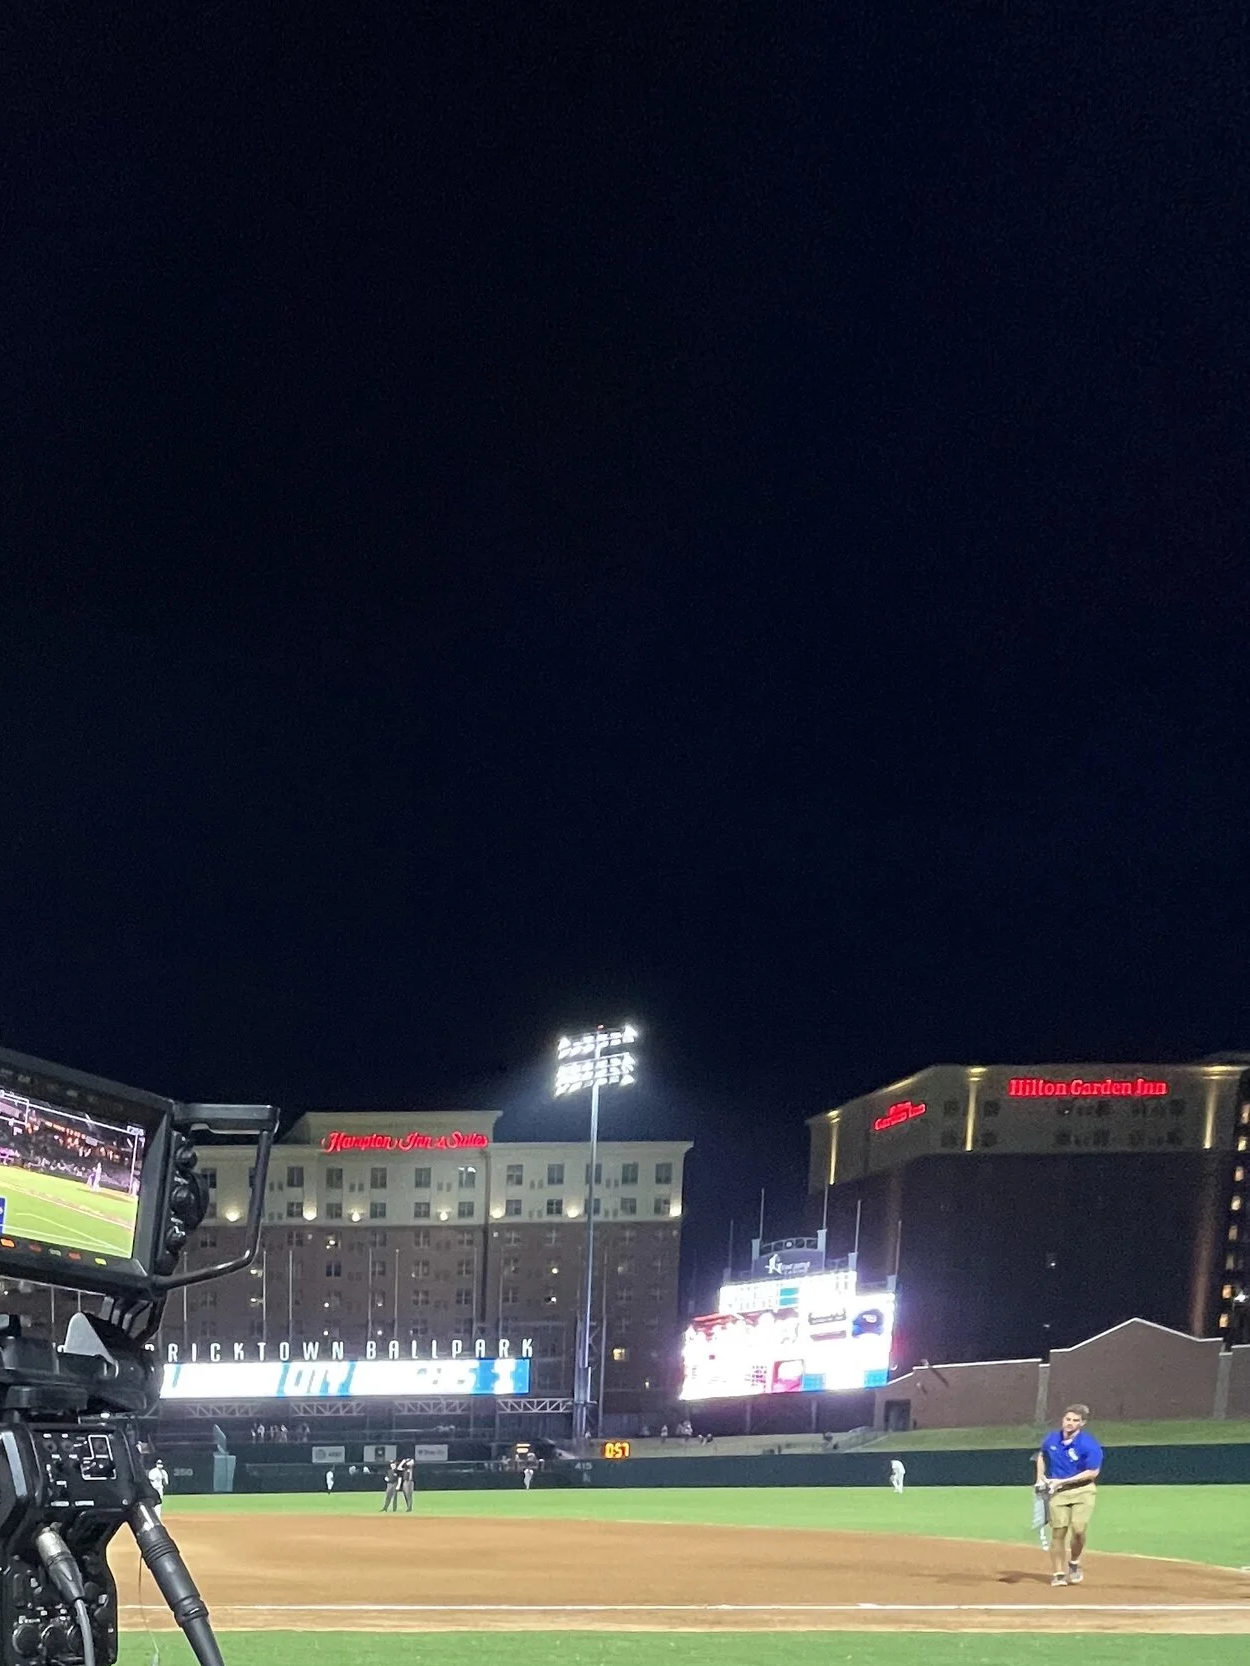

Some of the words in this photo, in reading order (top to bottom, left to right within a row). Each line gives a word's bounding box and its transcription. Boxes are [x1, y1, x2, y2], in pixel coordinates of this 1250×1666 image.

[1008, 1079, 1067, 1096] Hilton
[1069, 1080, 1132, 1096] Garden
[1134, 1078, 1167, 1096] Inn
[322, 1131, 397, 1153] Hampton
[398, 1131, 433, 1151] Inn
[447, 1130, 489, 1149] Suites
[365, 1337, 534, 1361] BALLPARK
